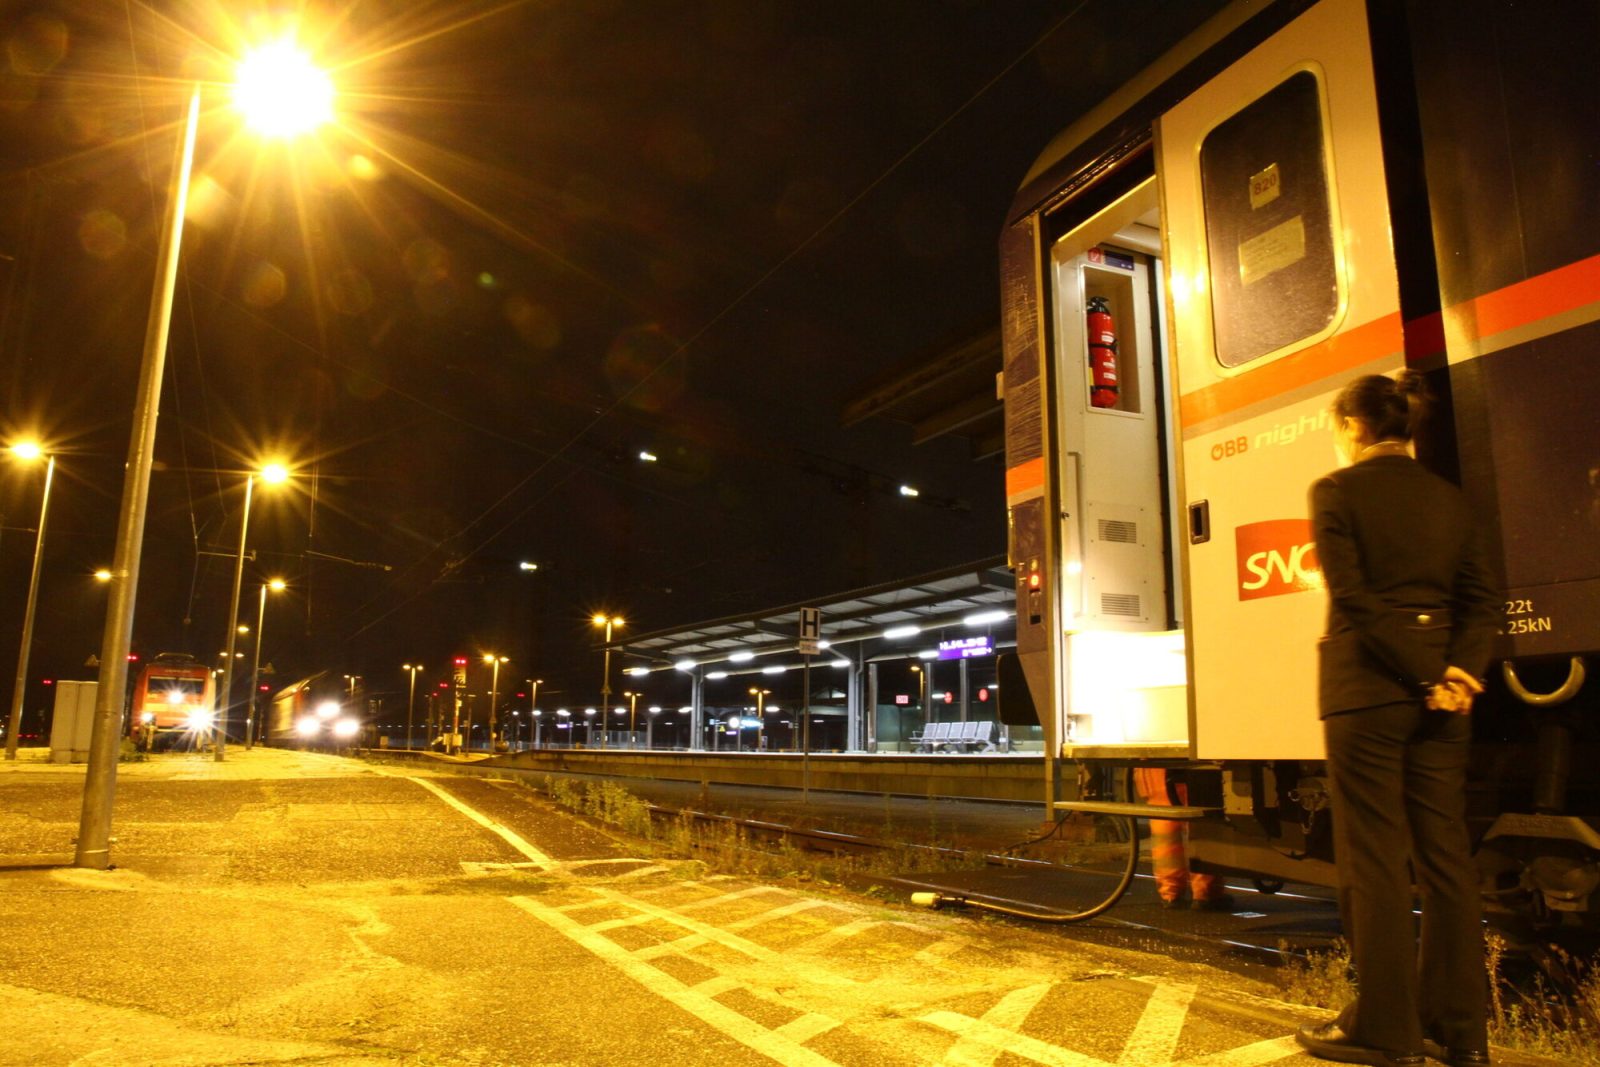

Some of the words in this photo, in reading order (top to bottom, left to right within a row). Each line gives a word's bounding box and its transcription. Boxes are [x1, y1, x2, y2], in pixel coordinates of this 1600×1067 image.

[1210, 436, 1248, 461] ÖBB
[802, 610, 819, 636] H
[1507, 617, 1551, 634] 25kN
